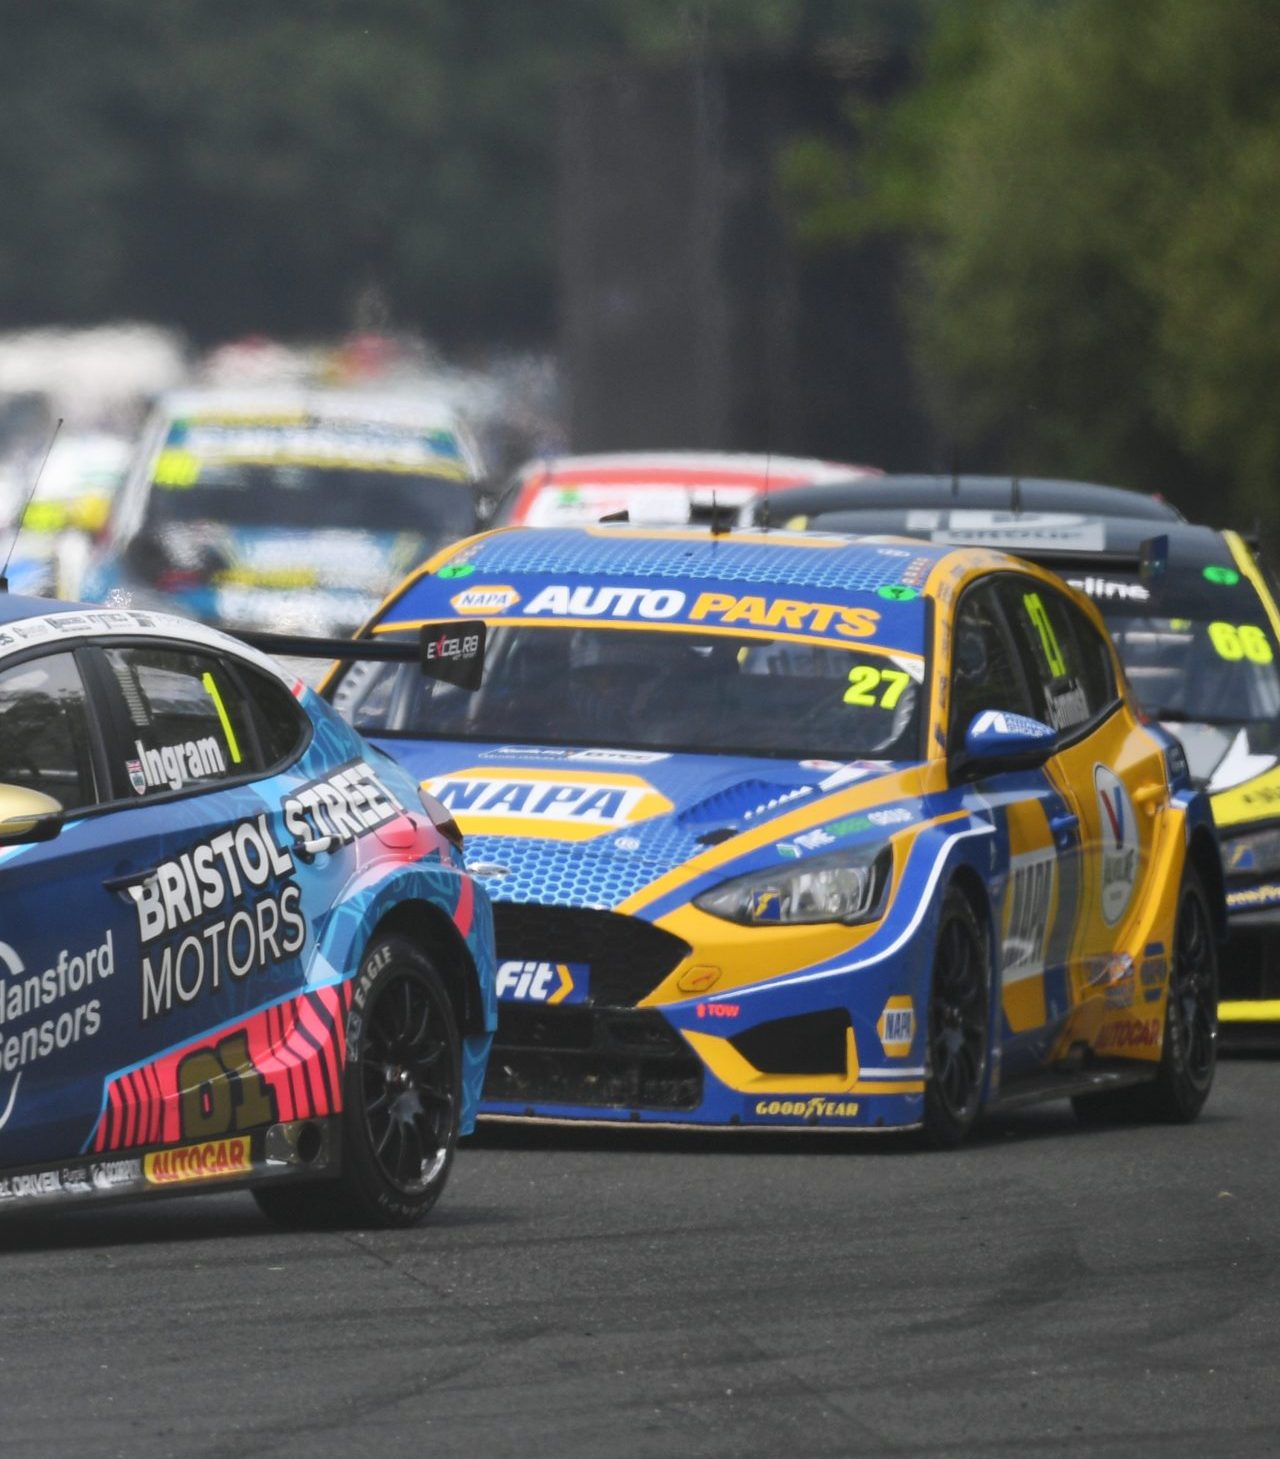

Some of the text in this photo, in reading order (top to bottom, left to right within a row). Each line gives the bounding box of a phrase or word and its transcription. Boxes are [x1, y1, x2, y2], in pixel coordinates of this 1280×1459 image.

[462, 586, 882, 637] NAPA AUTO PARTS
[1207, 621, 1274, 665] 66
[843, 665, 911, 710] 27
[134, 736, 226, 791] Ingram
[284, 761, 401, 846] STREET
[437, 781, 627, 819] NAPA
[128, 813, 295, 943] BRISTOL
[142, 885, 306, 1020] MOTORS
[354, 946, 392, 1010] EAGLE
[709, 1003, 741, 1017] TOW
[885, 1010, 913, 1041] NAPA
[177, 1028, 278, 1140] 01
[756, 1097, 859, 1119] GOODYEAR
[151, 1139, 245, 1181] AUTOCAR
